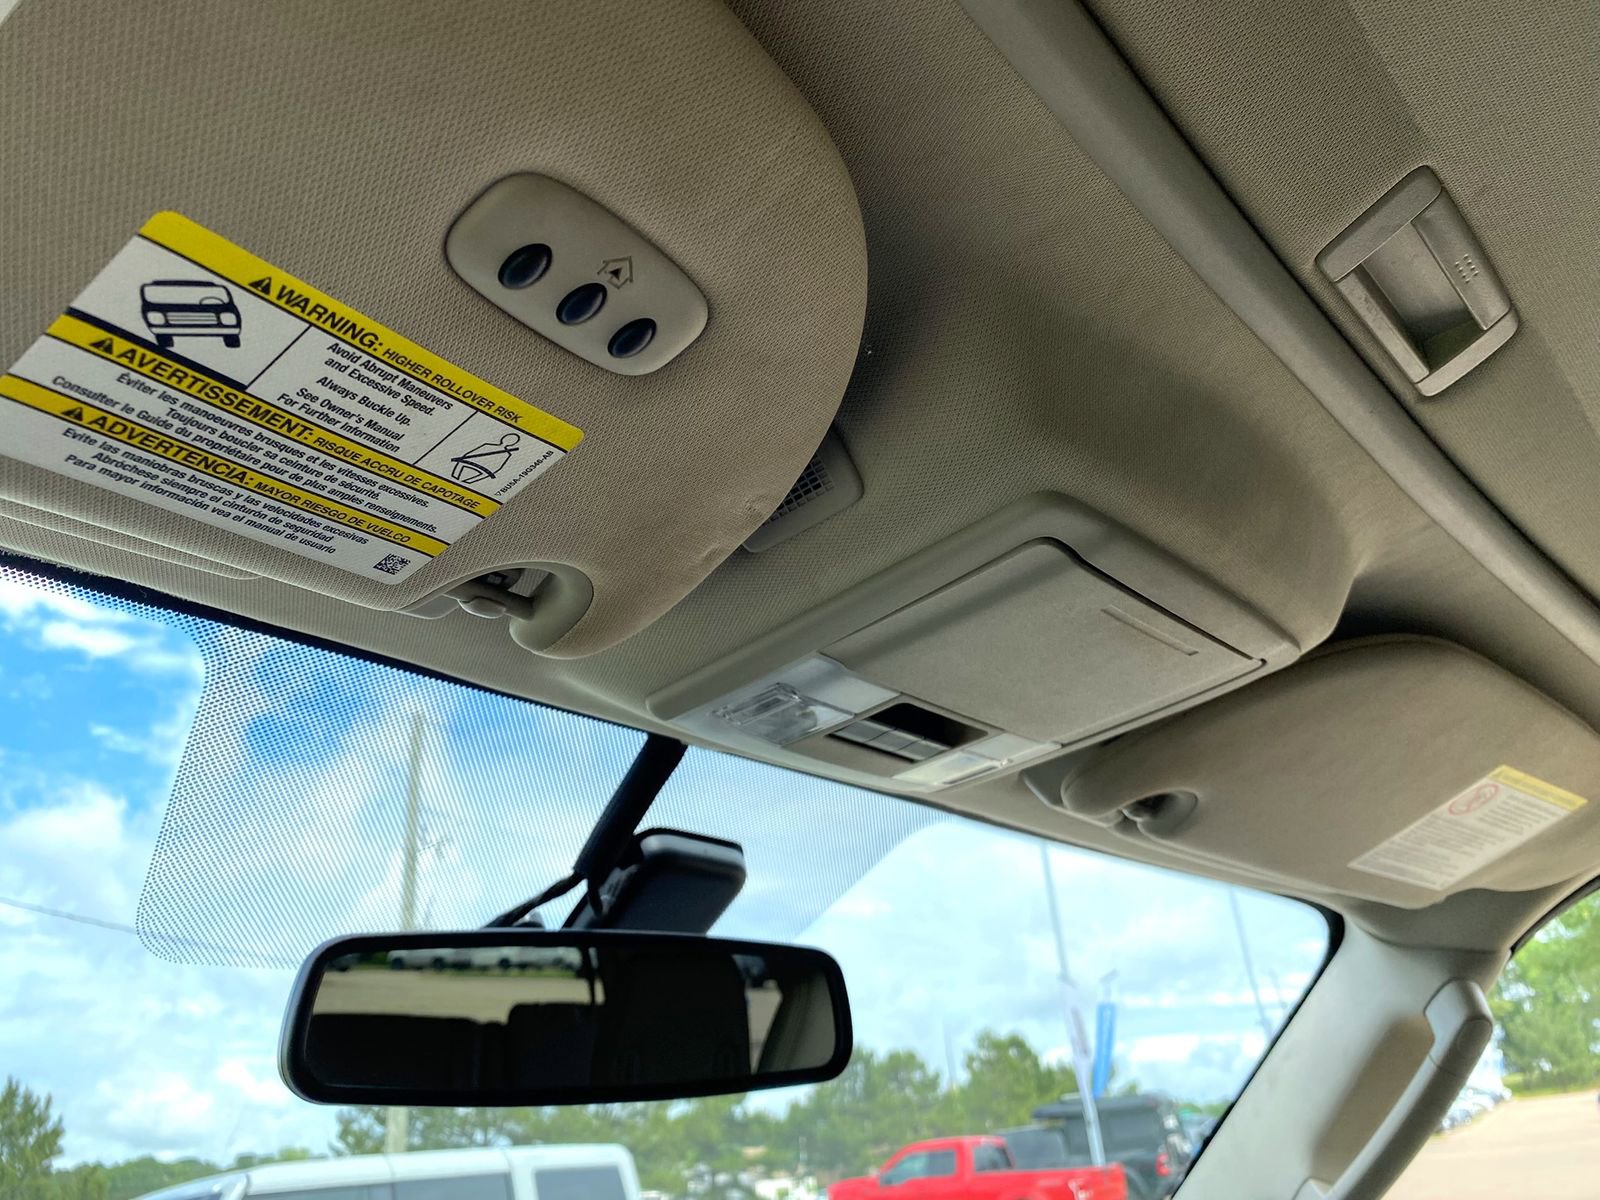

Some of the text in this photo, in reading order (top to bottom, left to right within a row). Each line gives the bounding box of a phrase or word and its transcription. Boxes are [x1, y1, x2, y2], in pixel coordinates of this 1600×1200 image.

[276, 284, 523, 424] WARNING: HIGHER ROLLOVER RISK
[315, 376, 411, 426] Always Buckle Up.
[324, 358, 436, 416] and Excessive Speed.
[326, 342, 454, 410] Avoid Abrupt Maneuvers
[52, 375, 437, 534] Consulter le Guide du propriétaire pour de plus amples renseignements.
[115, 372, 429, 508] Éviter les manoeuvres brusques et les vitesses excessives.
[116, 348, 481, 509] AVERTISSEMENT: RISQUE ACCRU DE CAPOTAGE
[165, 407, 381, 501] Toujours boucler sa ceinture de sécurité.
[276, 393, 401, 453] For Further Information
[296, 387, 406, 441] See Owner's Manual
[62, 427, 369, 545] Evite las maniobras bruscas y las velocidades excesivas
[64, 454, 336, 554] Para mayor información vea el manual de usuario
[87, 415, 411, 543] ADVERTENCIA: MAYOR RIESGO DE VUELCO
[91, 452, 335, 543] Abróchese siempre el cinturón de seguridad
